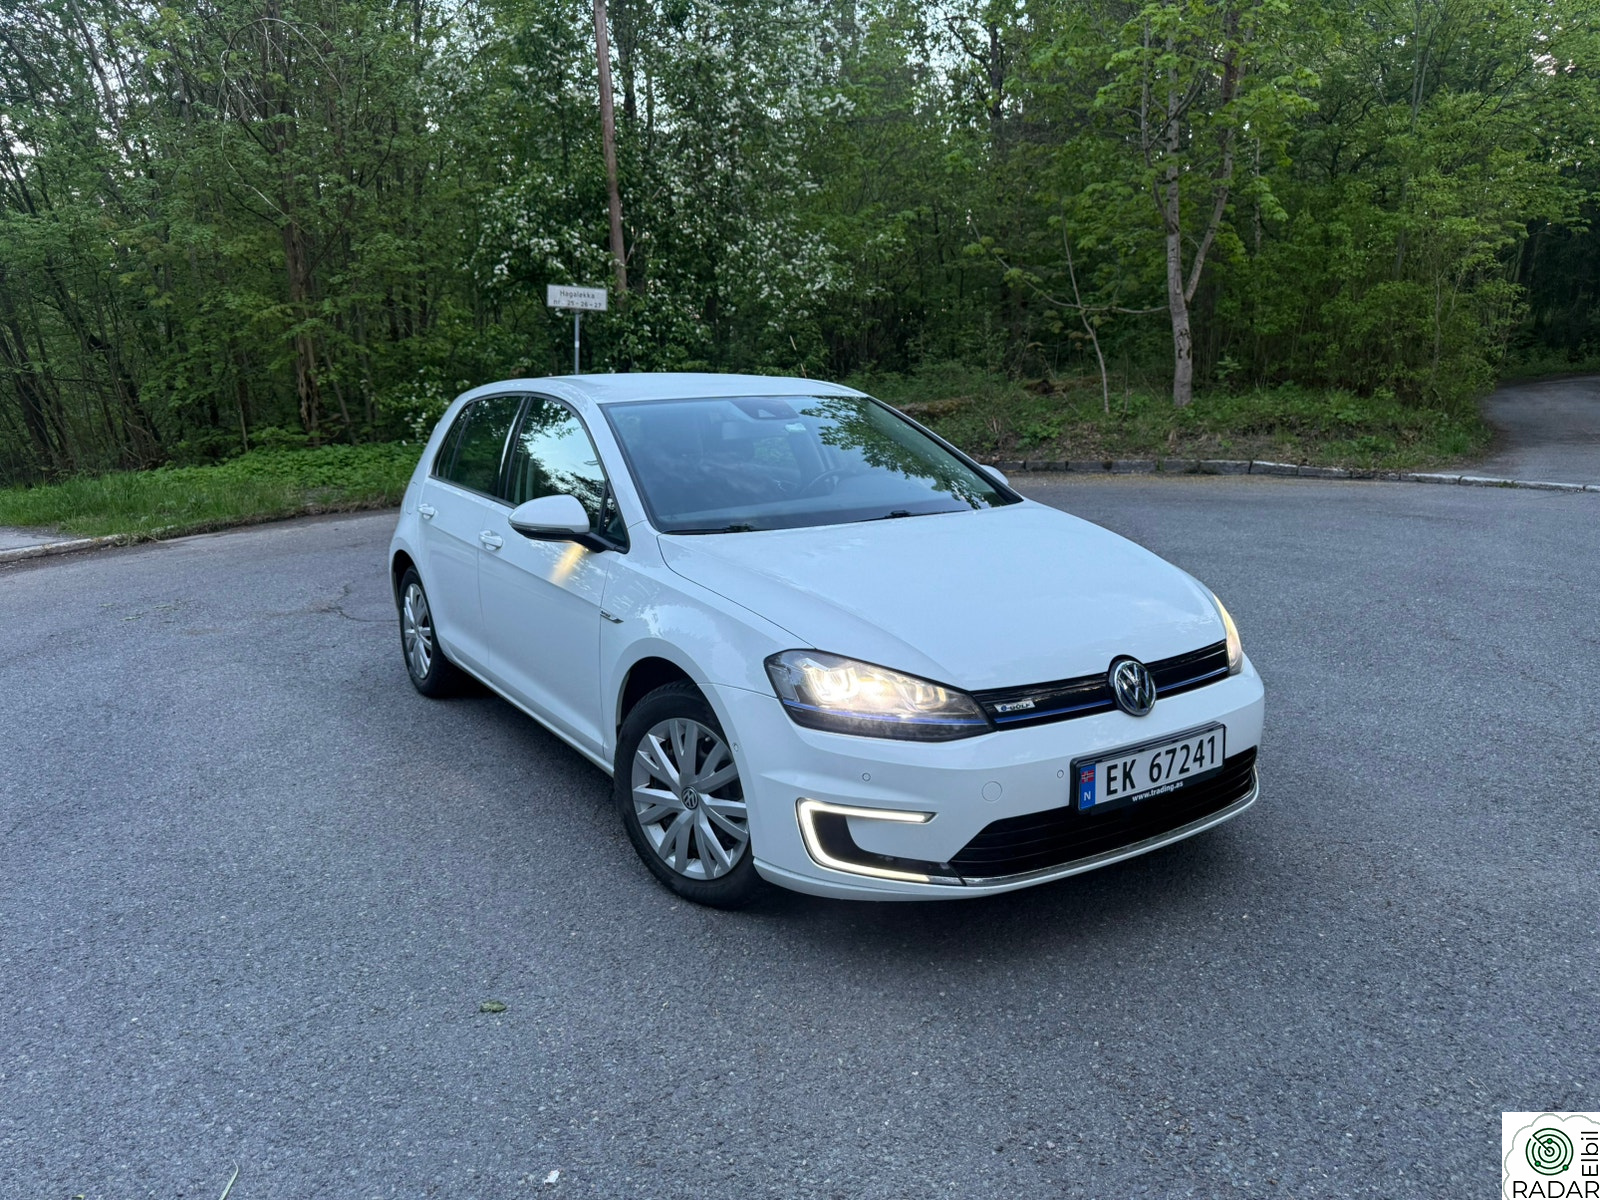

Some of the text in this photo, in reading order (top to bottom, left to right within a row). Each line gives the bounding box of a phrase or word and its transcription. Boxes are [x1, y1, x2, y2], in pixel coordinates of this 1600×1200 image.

[1106, 735, 1215, 796] EK 67241
[1083, 791, 1091, 801] N
[1132, 781, 1184, 802] www.trading.as
